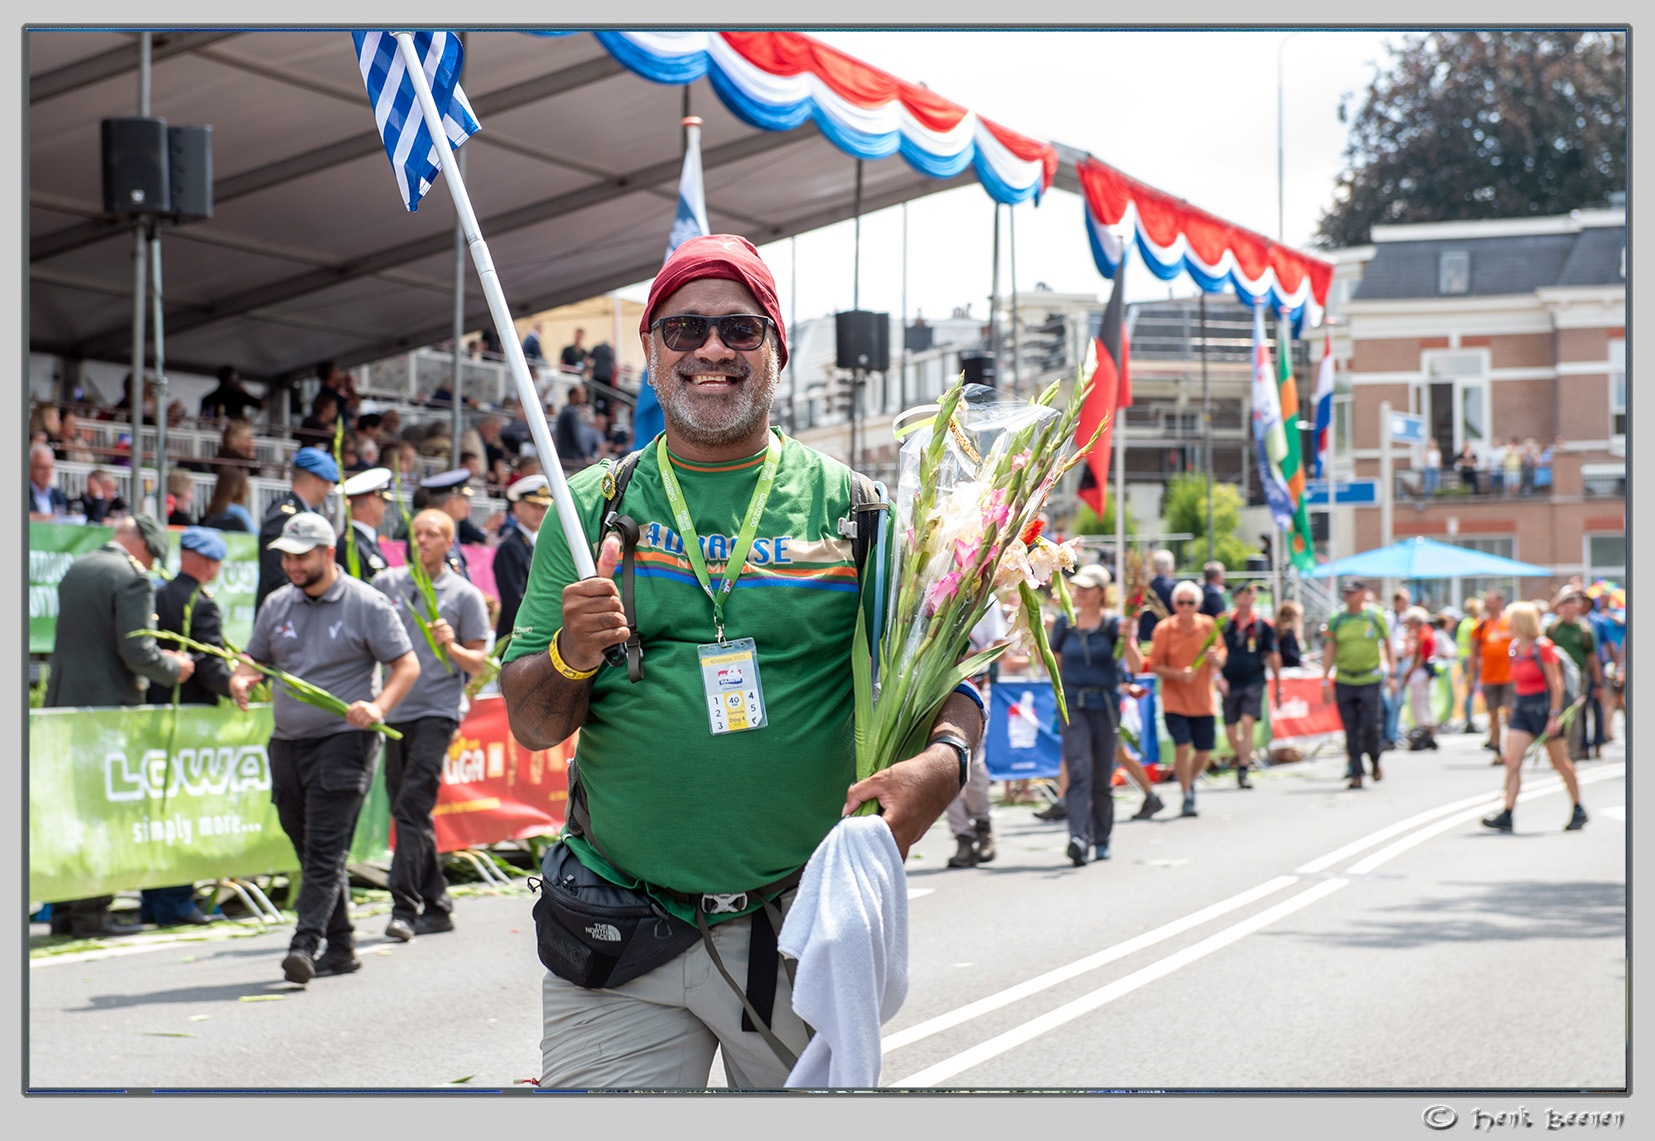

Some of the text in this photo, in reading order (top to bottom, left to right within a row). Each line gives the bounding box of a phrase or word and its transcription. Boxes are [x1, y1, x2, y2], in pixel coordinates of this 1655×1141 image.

[714, 697, 719, 705] 1
[729, 696, 740, 704] 40
[750, 704, 756, 712] 5
[715, 709, 721, 717] 2
[105, 745, 272, 802] LOWA
[132, 812, 192, 846] simply
